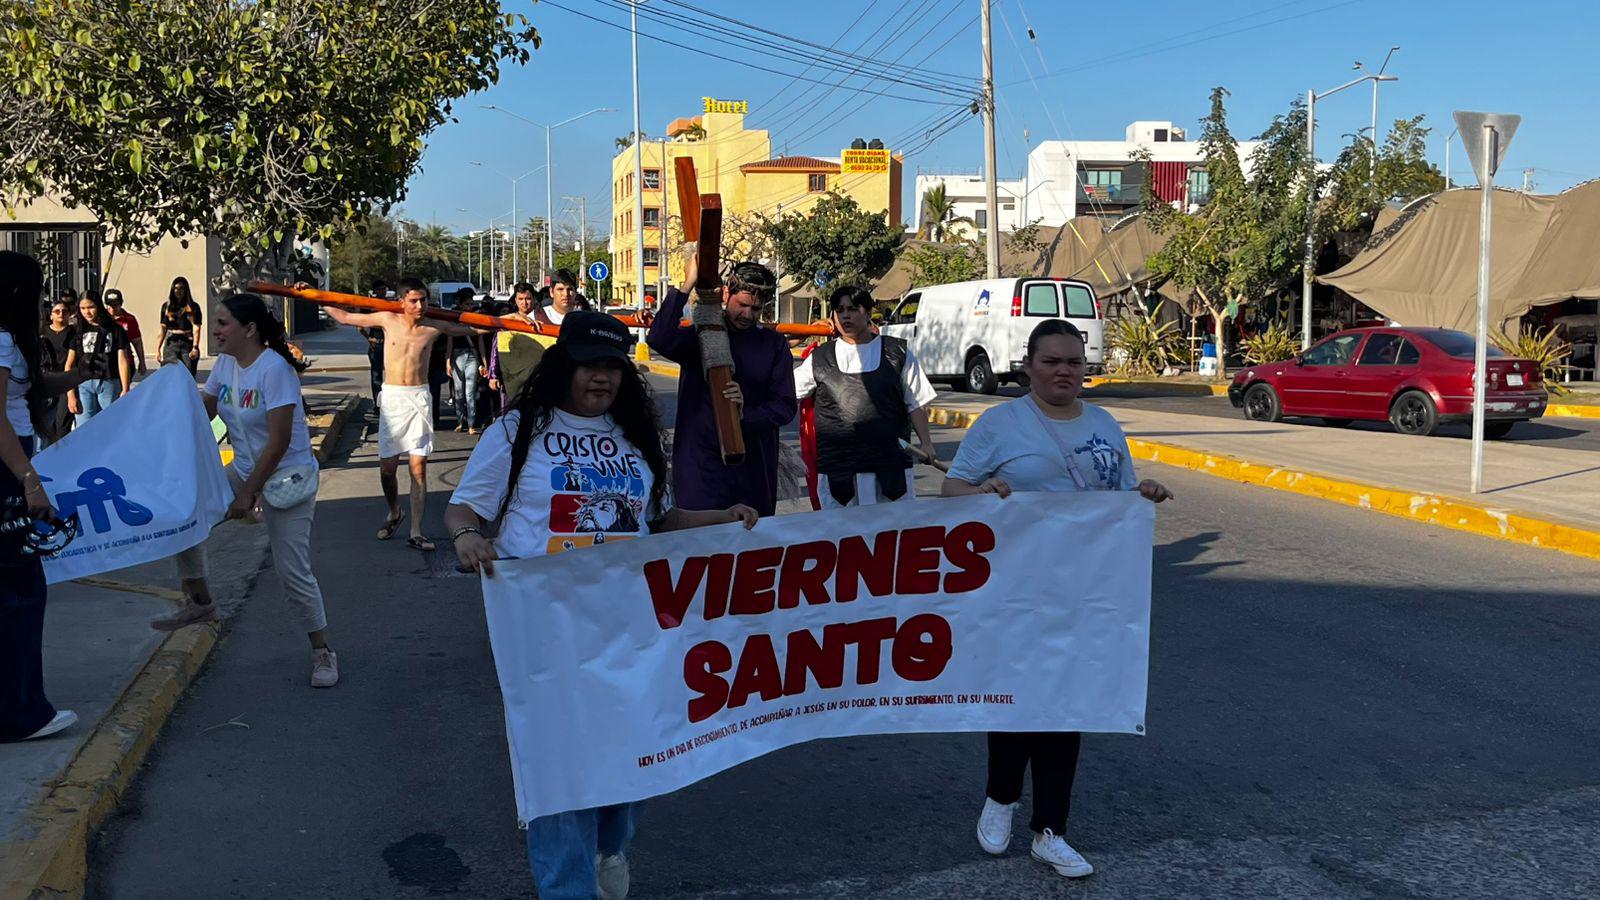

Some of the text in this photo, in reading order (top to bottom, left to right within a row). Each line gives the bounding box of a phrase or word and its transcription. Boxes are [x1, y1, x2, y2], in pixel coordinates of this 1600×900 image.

[702, 97, 748, 114] Hotel
[543, 432, 618, 461] CRISTO
[591, 454, 641, 479] VIVE
[643, 521, 995, 630] VIERNES
[684, 613, 953, 723] SANTO
[638, 755, 655, 769] HOY
[657, 752, 666, 763] ES
[667, 747, 676, 760] UN
[740, 720, 749, 731] DE
[750, 708, 794, 728] ACOMPAÑAR
[803, 701, 826, 714] JESÚS
[827, 701, 838, 711] EN
[840, 699, 851, 709] SU
[879, 696, 890, 706] EN
[891, 696, 903, 706] SU
[957, 694, 968, 702] EN
[970, 694, 981, 704] SU
